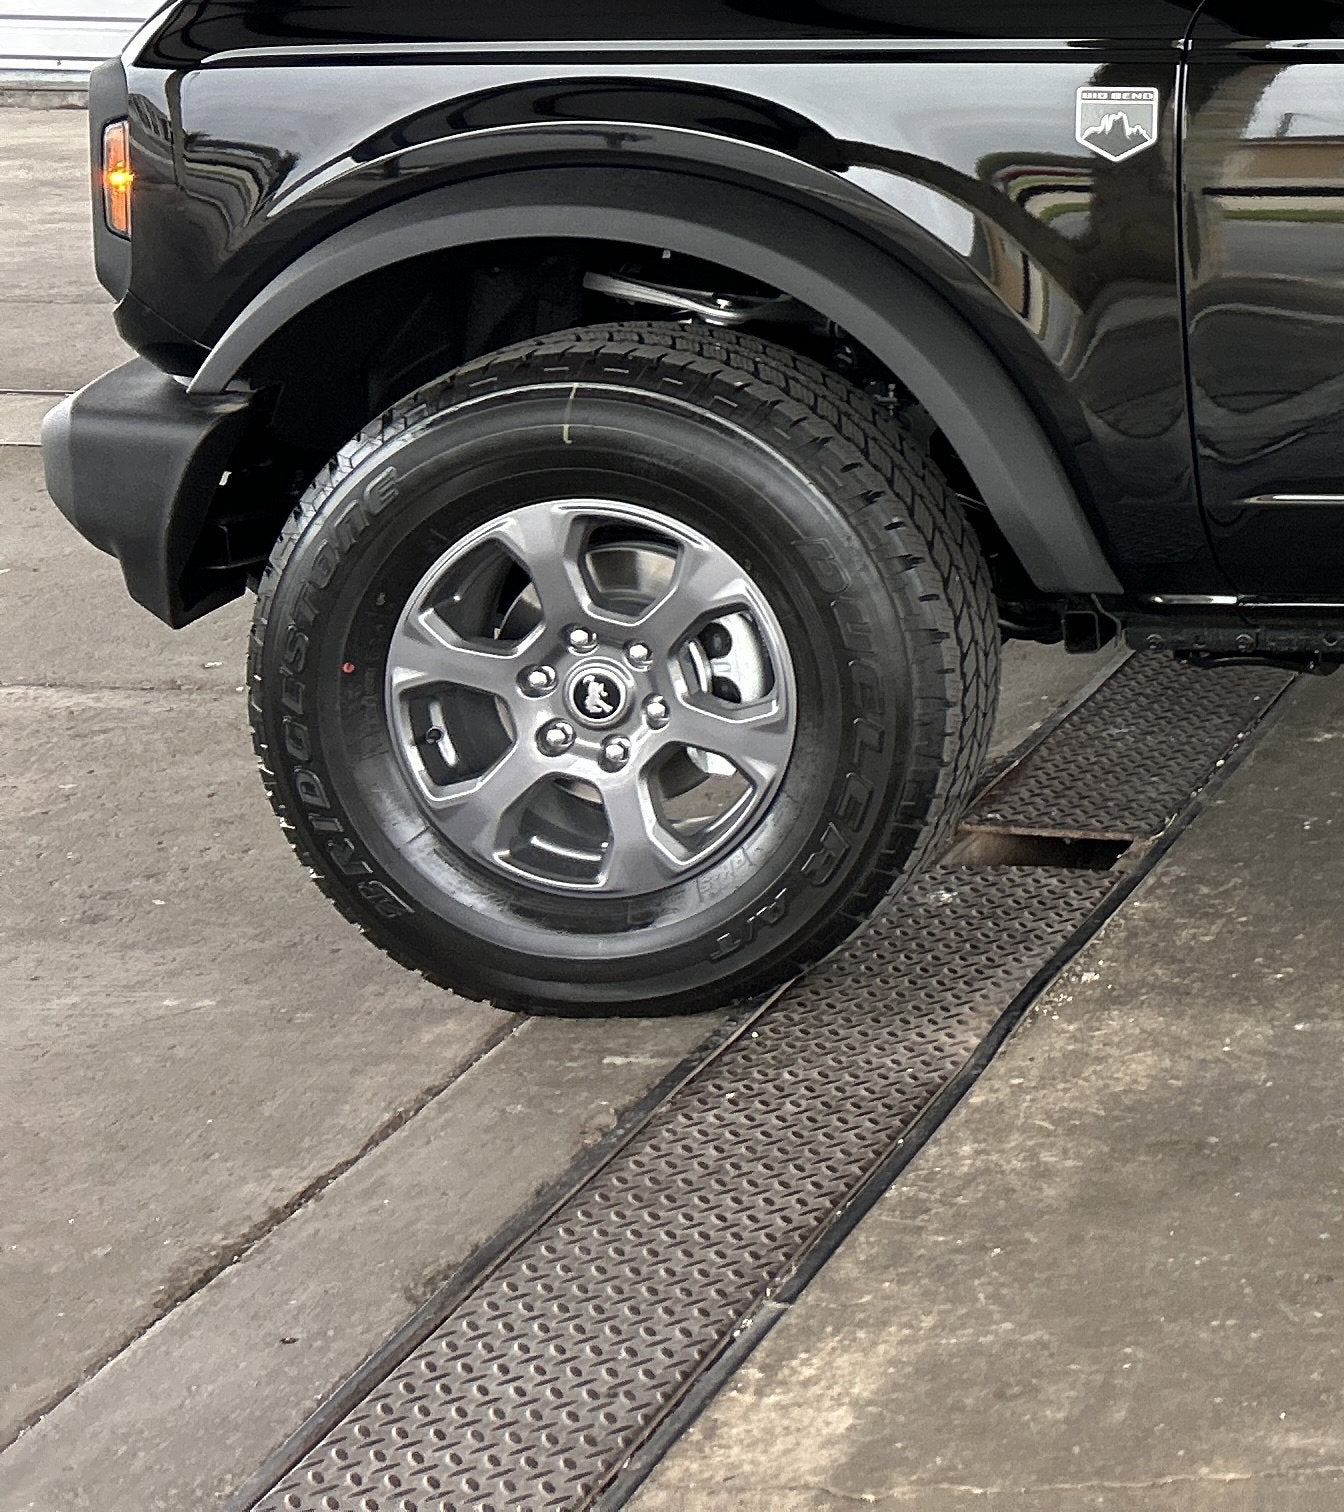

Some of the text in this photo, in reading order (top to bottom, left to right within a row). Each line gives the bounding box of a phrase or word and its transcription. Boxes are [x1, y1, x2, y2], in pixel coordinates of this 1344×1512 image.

[1111, 92, 1154, 100] BEND
[279, 465, 416, 919] BRIDGESTONE
[790, 534, 886, 887] DUELER
